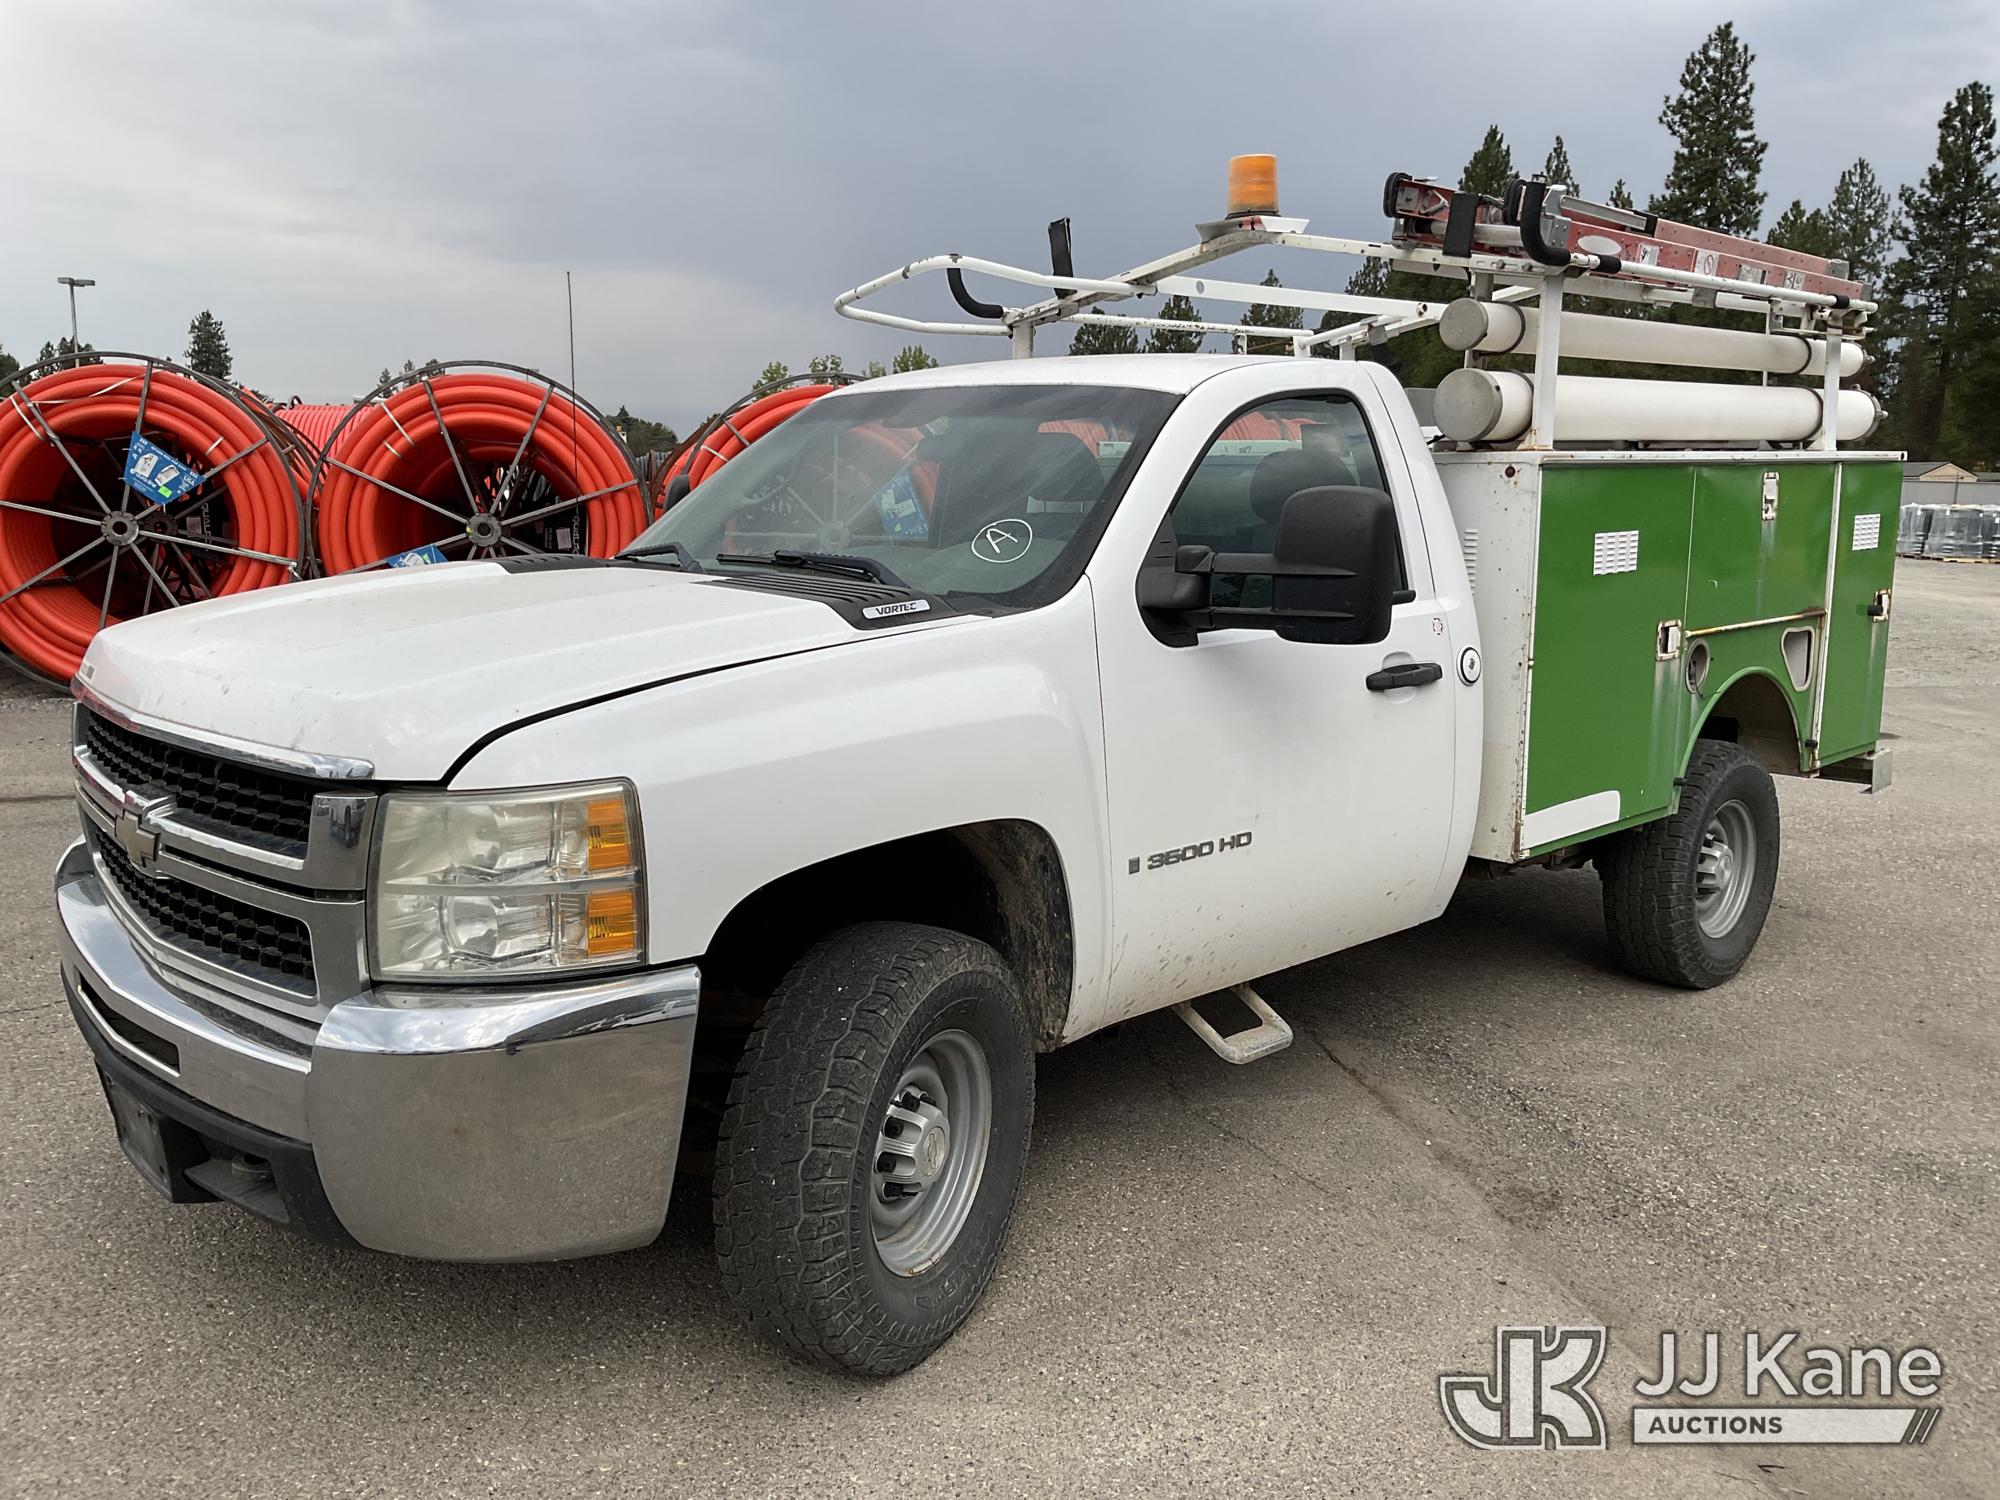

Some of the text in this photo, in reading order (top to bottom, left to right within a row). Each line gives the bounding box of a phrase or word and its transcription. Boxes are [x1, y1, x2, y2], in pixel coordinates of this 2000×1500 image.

[985, 527, 1019, 554] A
[875, 602, 917, 615] VORTEC
[1147, 831, 1253, 870] 3500 HD
